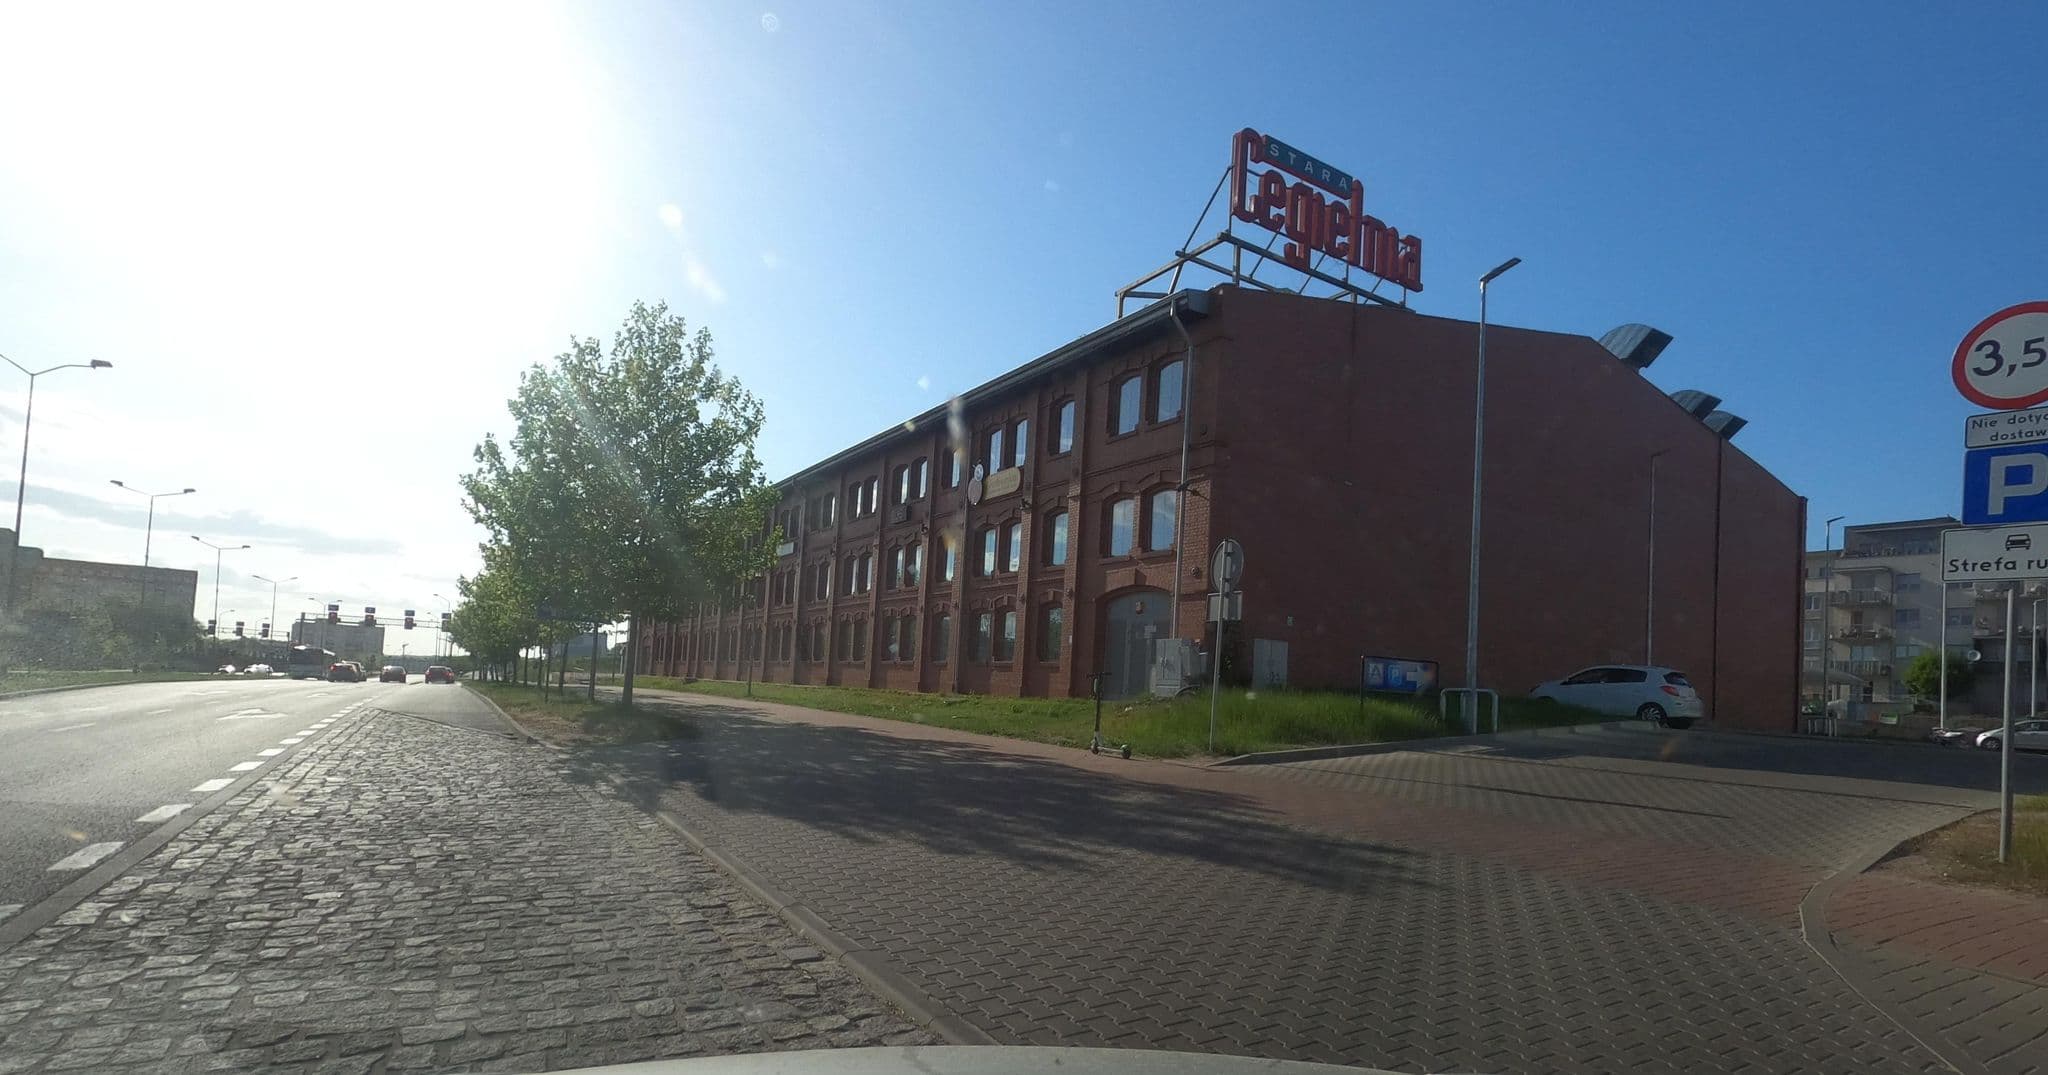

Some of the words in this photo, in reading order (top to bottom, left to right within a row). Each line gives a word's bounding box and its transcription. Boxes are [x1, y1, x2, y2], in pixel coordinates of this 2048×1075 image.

[1270, 143, 1347, 189] STARA
[1972, 336, 2047, 377] 3,5
[1972, 418, 1998, 430] Nie
[1989, 428, 2047, 442] dostaw
[1987, 453, 2048, 515] P
[1947, 556, 2017, 573] Strefa
[2027, 559, 2048, 570] ru
